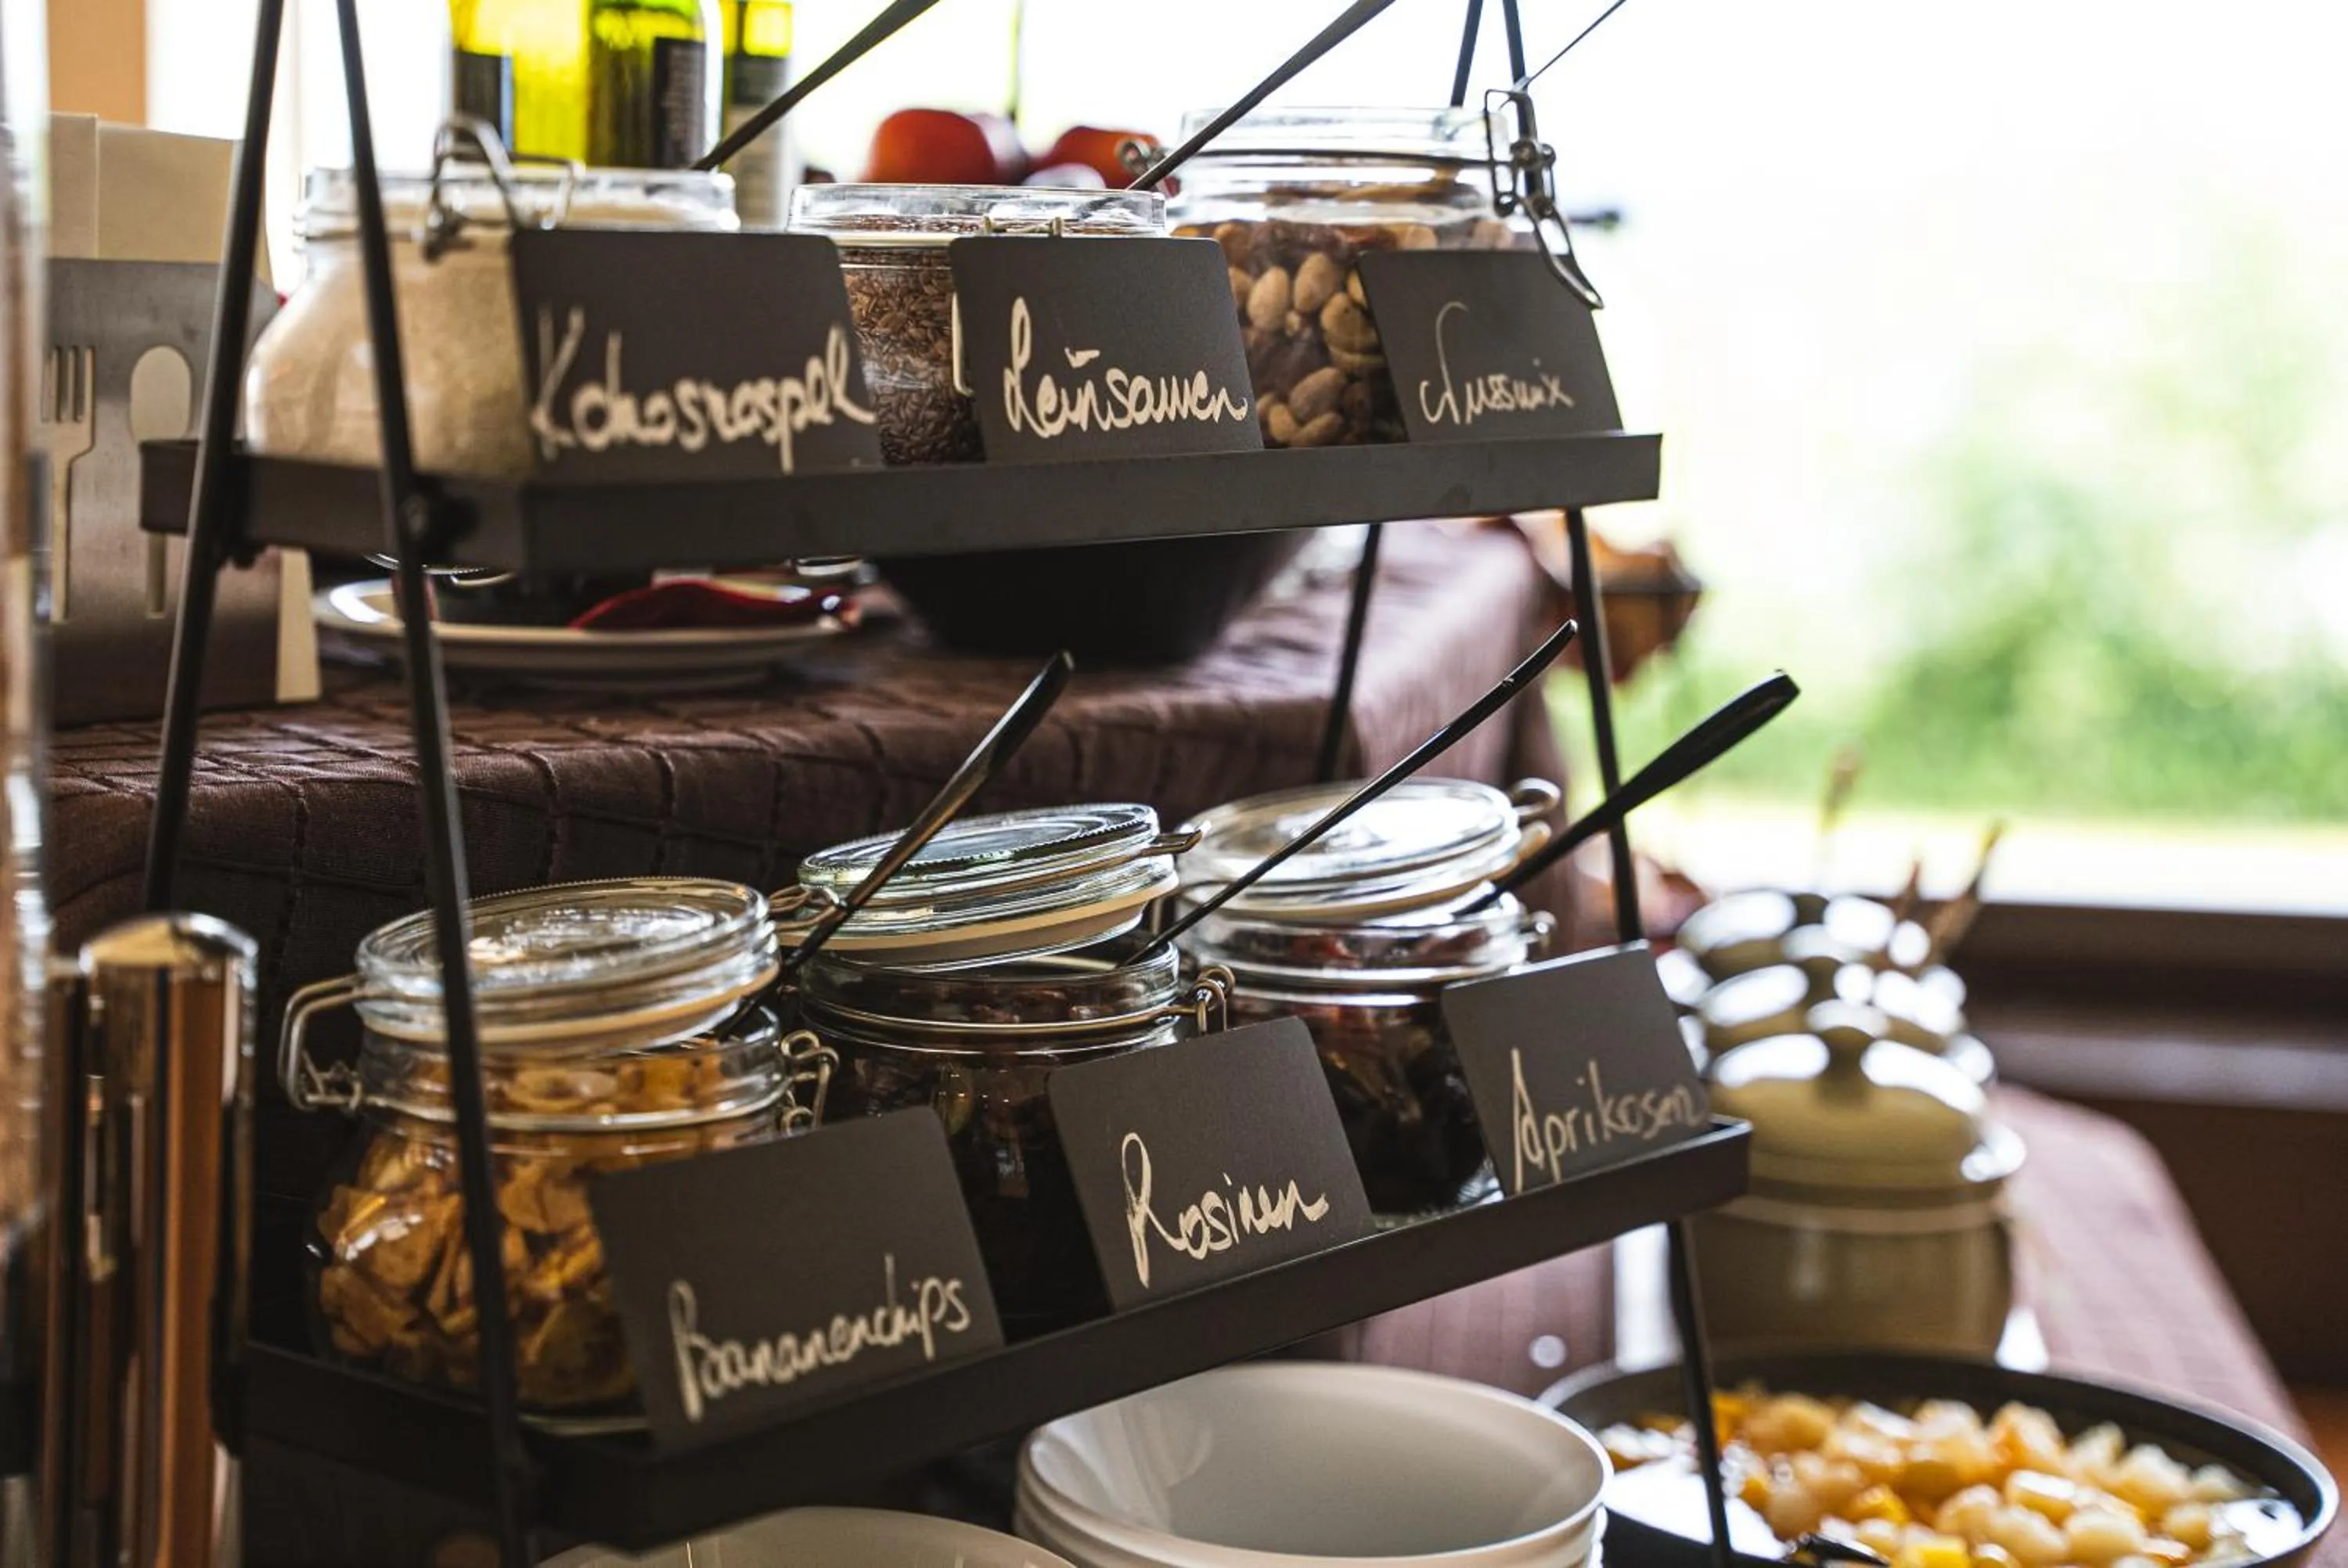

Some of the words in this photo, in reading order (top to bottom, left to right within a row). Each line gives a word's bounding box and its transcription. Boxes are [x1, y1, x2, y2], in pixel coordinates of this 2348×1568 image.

[1003, 296, 1248, 438] Leinsamen
[1511, 1046, 1705, 1195] Aprikosen
[1122, 1132, 1330, 1289] Rosinen
